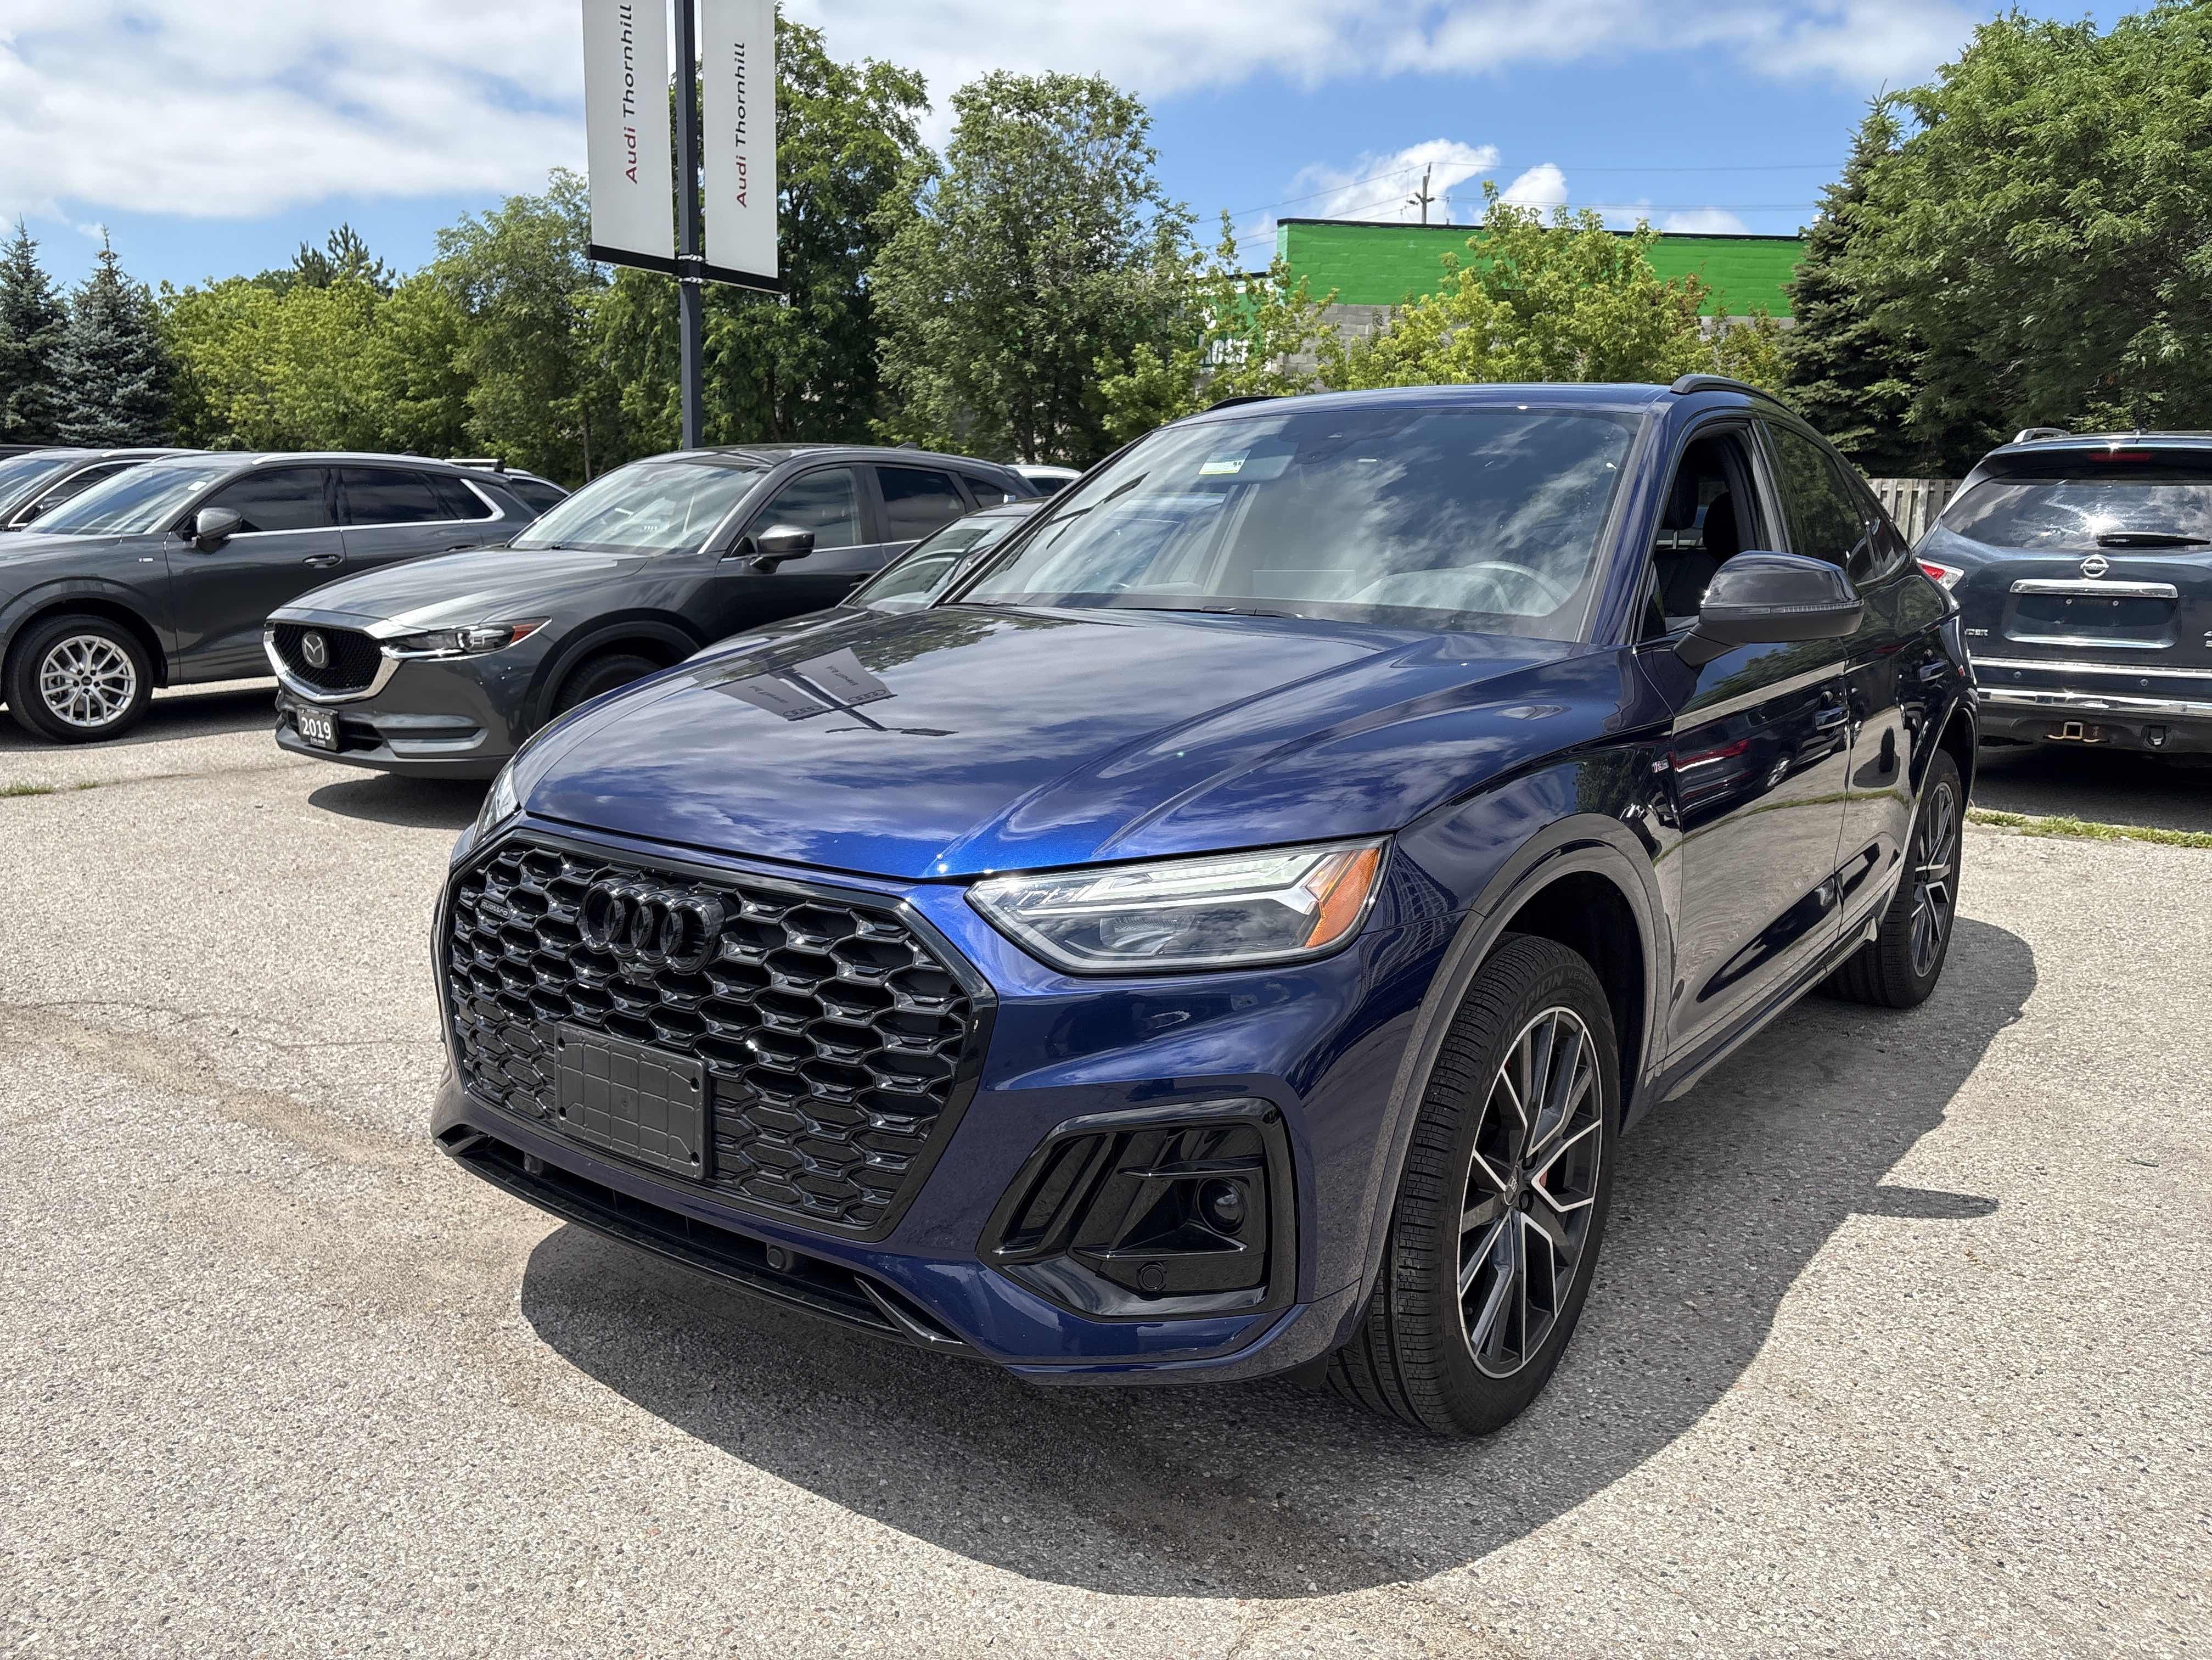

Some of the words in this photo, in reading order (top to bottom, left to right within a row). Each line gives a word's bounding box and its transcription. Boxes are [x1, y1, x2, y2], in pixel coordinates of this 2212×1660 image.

[619, 4, 635, 118] Thornhill
[734, 42, 746, 147] Thornhill
[624, 126, 638, 184] Audi
[736, 155, 747, 209] Audi
[301, 716, 332, 741] 2019
